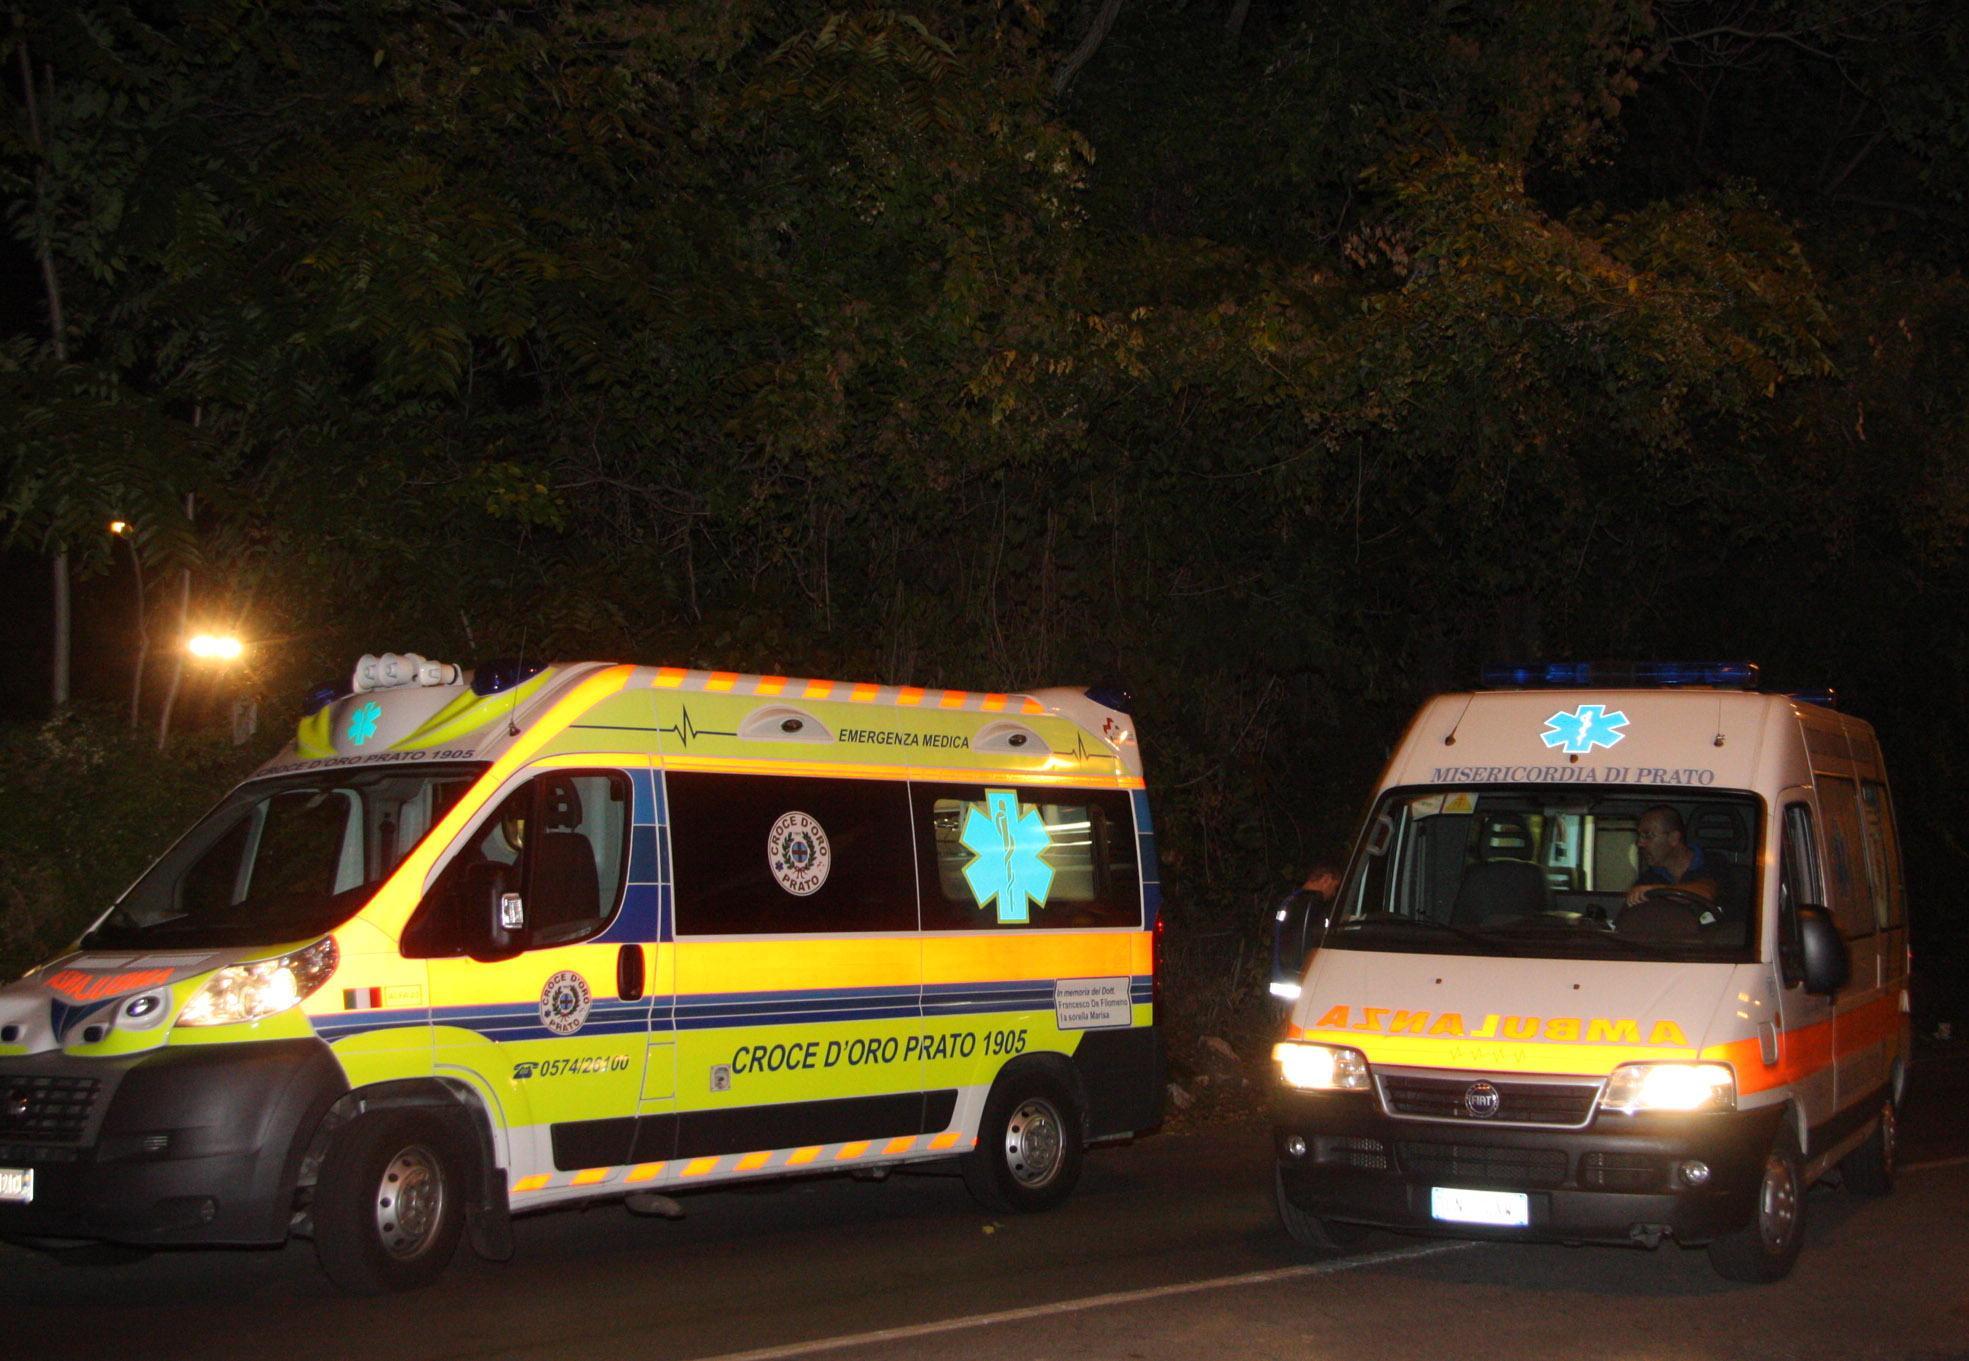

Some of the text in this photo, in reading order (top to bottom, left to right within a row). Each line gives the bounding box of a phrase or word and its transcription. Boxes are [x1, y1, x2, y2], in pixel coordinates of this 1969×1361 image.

[839, 729, 969, 749] EMERGENZA MEDICA
[364, 751, 426, 763] PRATO
[432, 750, 475, 760] 1905
[1429, 766, 1715, 786] MISERICORDIA DI PRATO
[771, 816, 827, 856] CROCE D'ORO
[782, 874, 819, 891] PRATO
[543, 974, 589, 1005] CROCE D'ORO
[549, 1019, 579, 1031] PRATO
[732, 1029, 1028, 1074] CROCE D'ORO PRATO 1905
[1471, 1095, 1492, 1106] FIAT
